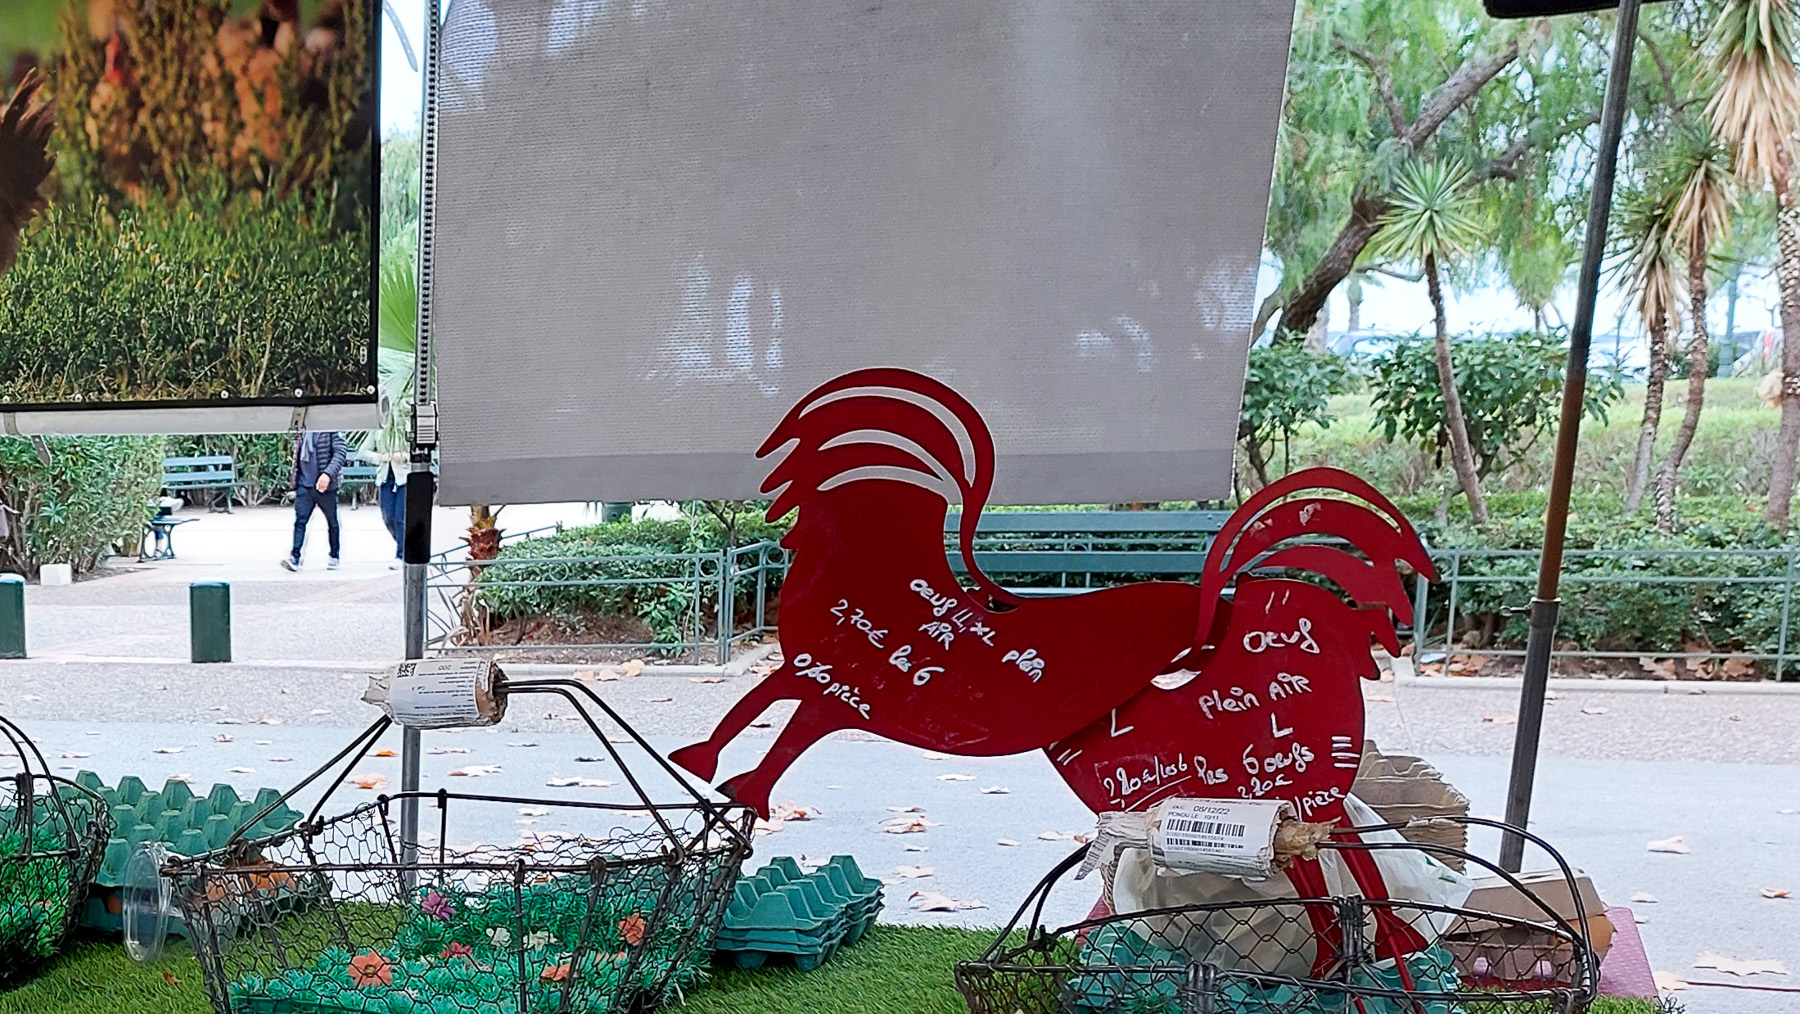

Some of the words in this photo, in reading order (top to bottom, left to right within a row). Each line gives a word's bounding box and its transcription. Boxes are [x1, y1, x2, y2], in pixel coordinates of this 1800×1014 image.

[913, 666, 945, 686] 6
[1110, 708, 1134, 737] L
[1270, 712, 1293, 738] L
[1242, 743, 1260, 775] 6
[1193, 805, 1231, 815] 08/12/22
